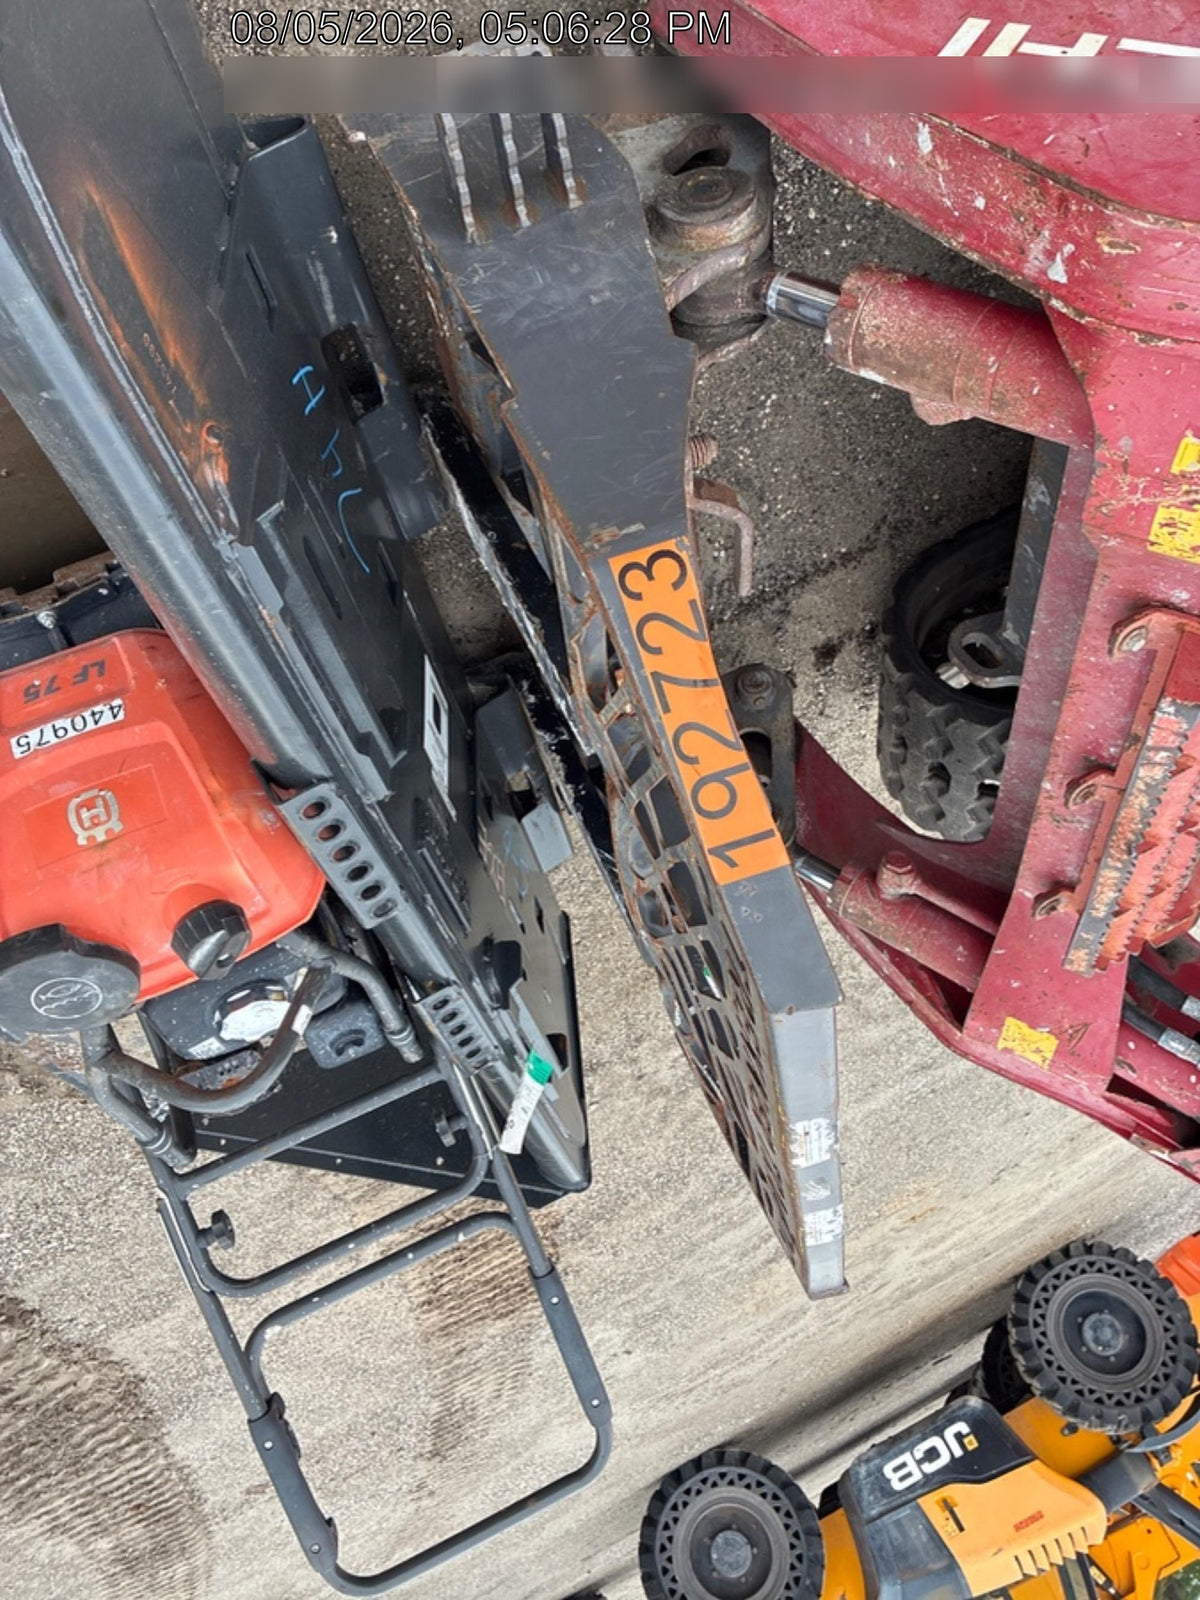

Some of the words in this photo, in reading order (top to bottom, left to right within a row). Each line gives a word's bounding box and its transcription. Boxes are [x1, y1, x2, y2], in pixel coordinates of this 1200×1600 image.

[23, 674, 63, 705] 75
[72, 658, 107, 686] LF
[16, 702, 123, 755] 440975
[617, 548, 777, 869] 192723
[882, 1420, 973, 1492] JCB
